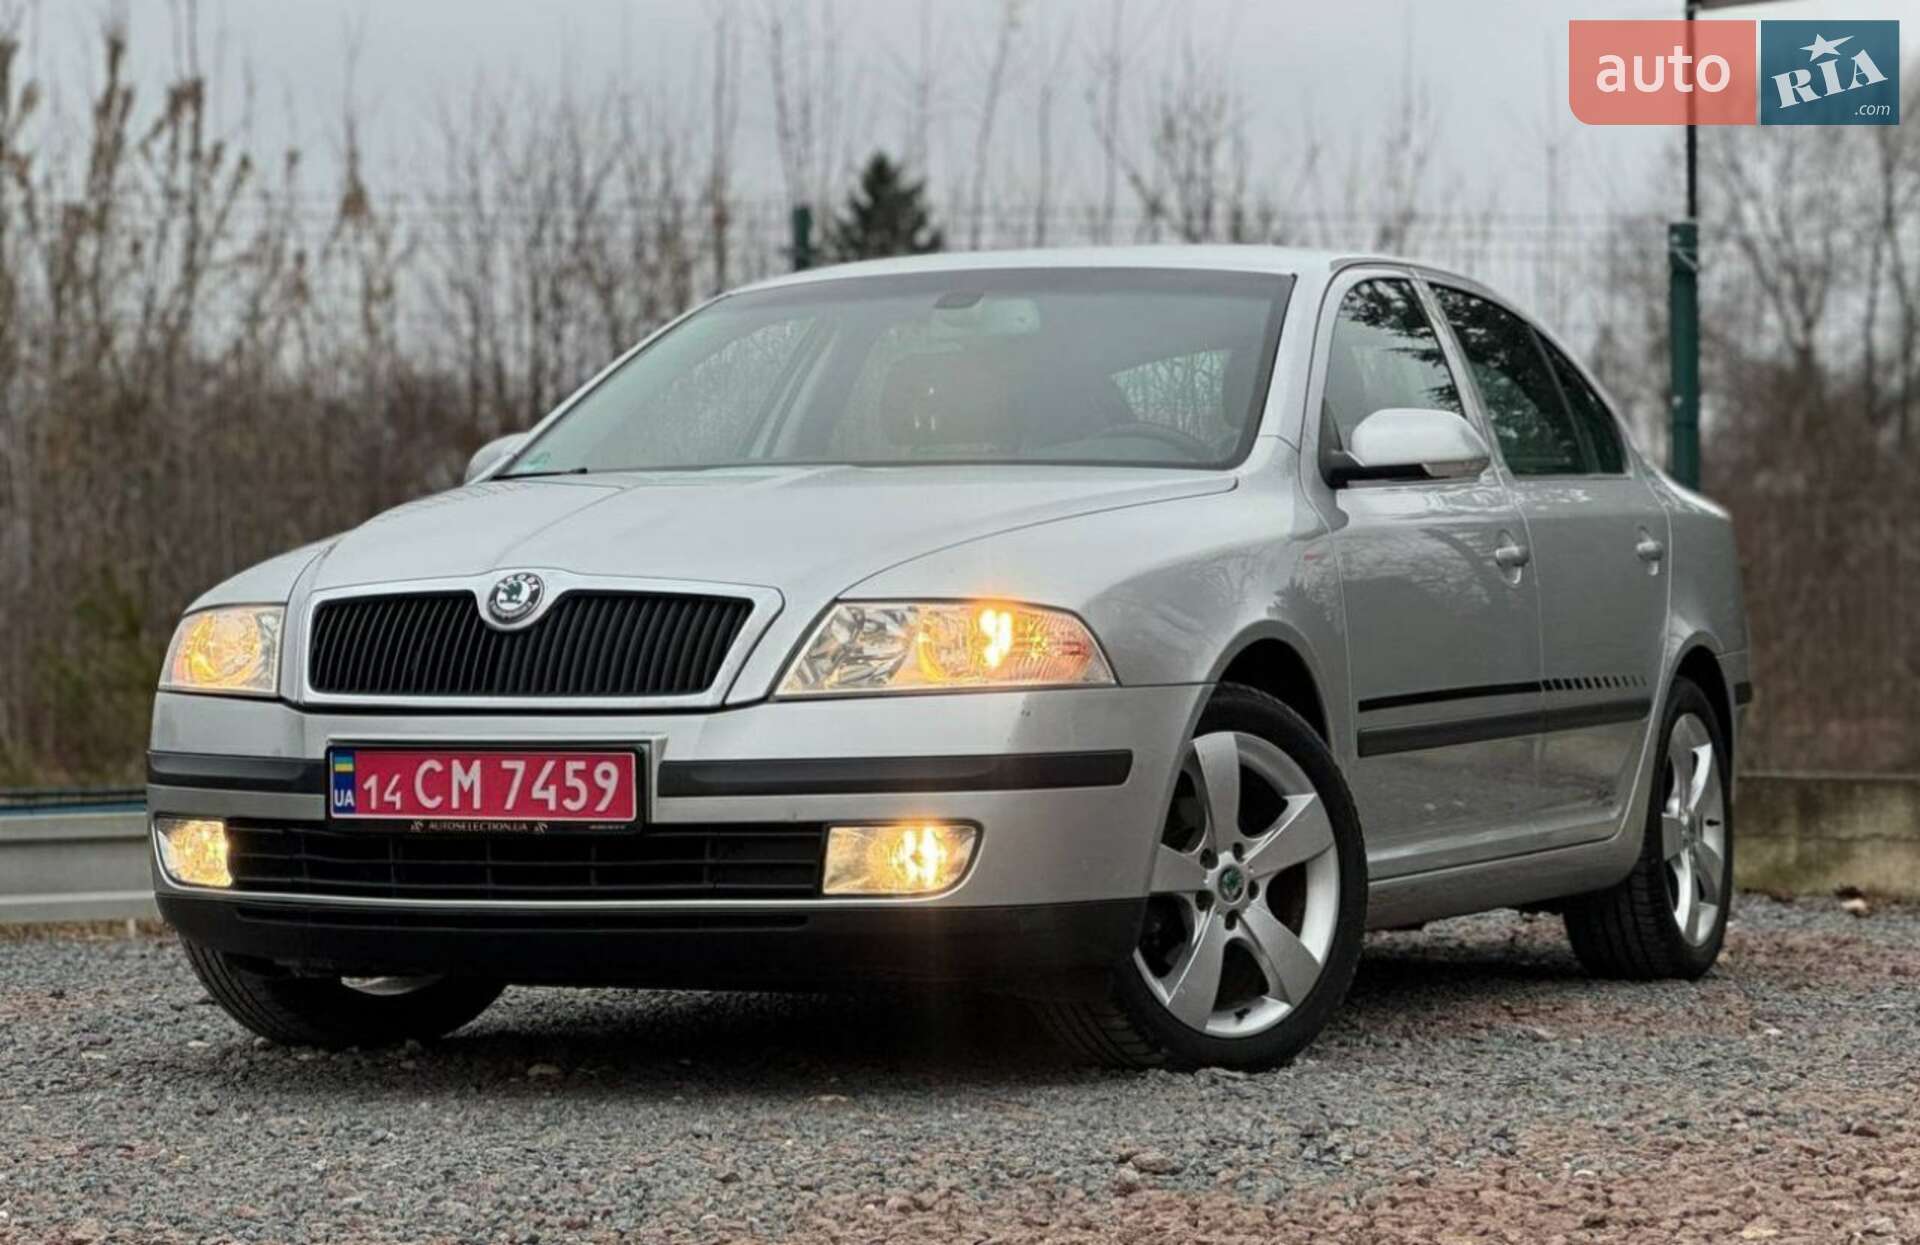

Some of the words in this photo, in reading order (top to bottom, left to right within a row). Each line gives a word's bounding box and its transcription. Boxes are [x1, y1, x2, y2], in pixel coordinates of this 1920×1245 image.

[334, 788, 355, 807] UA
[362, 773, 402, 810] 14
[414, 758, 482, 809] CM
[501, 760, 620, 812] 7459
